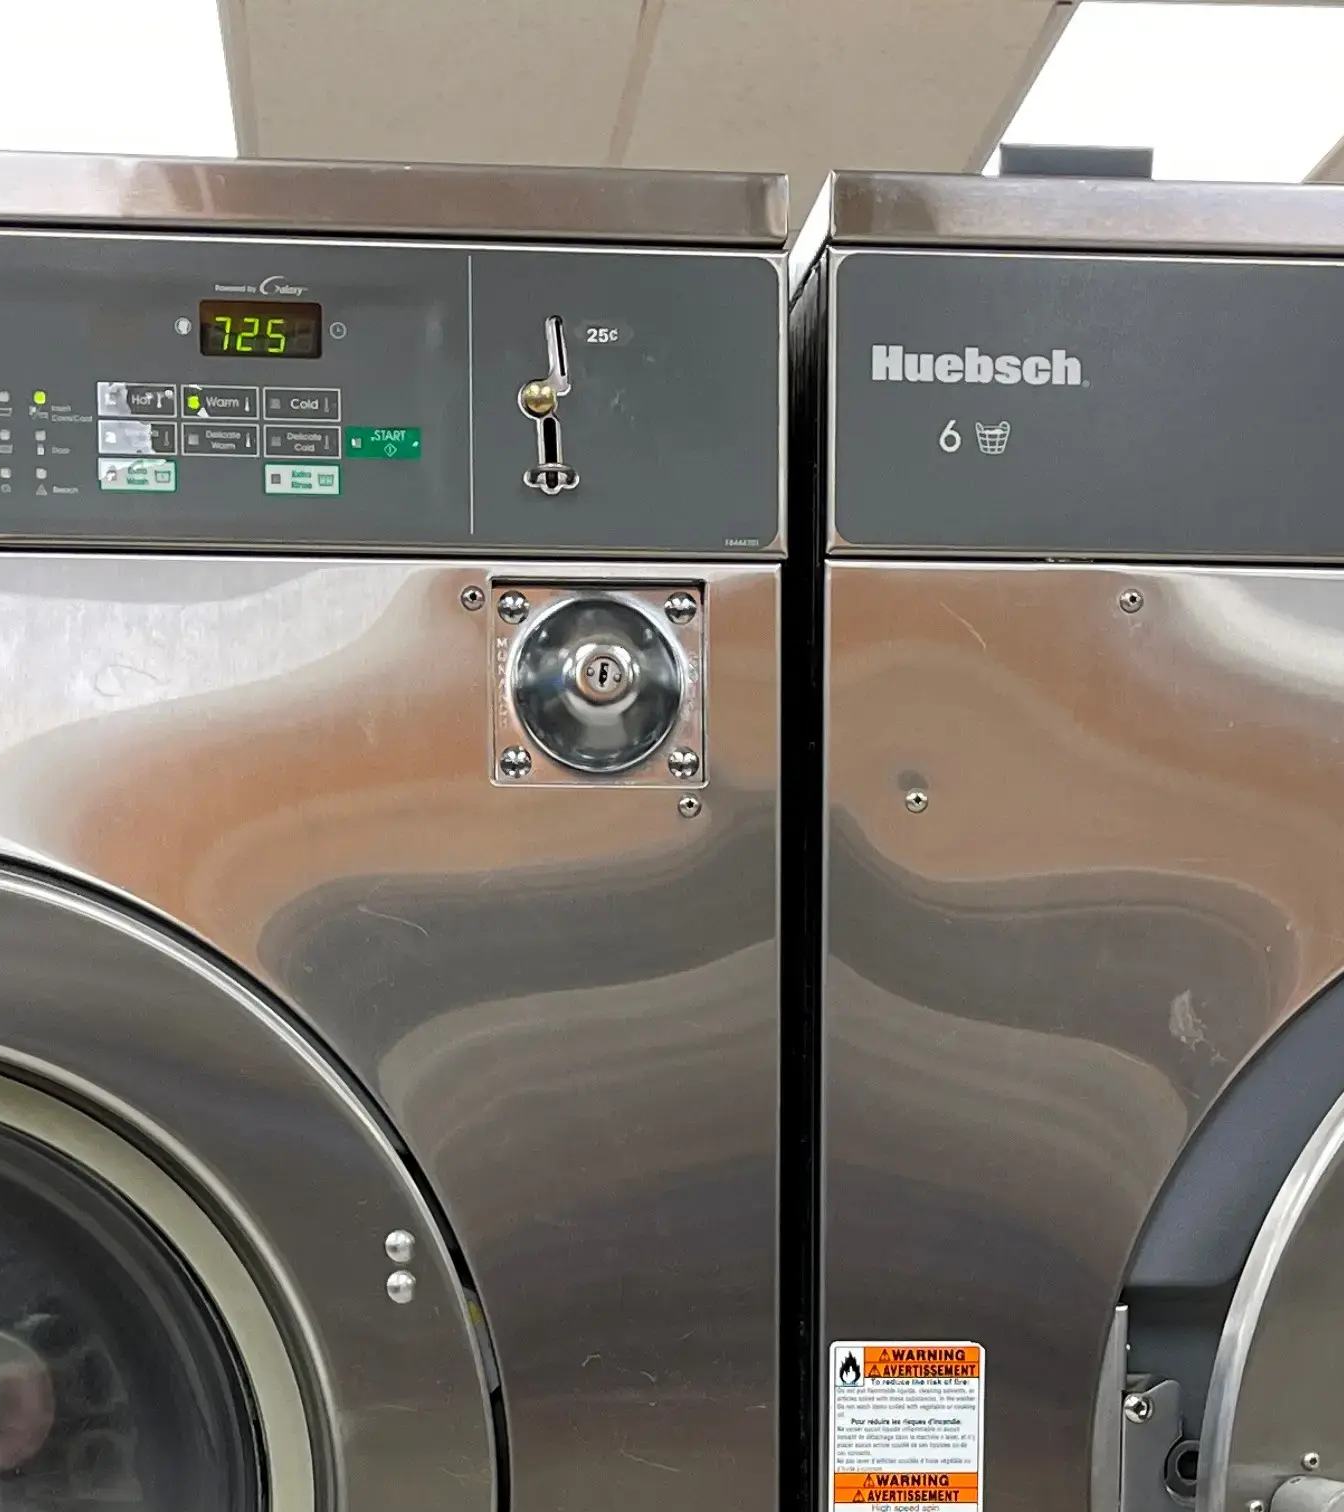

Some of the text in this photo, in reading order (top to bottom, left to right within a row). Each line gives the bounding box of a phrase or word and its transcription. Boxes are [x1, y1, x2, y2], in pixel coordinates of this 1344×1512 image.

[247, 285, 256, 294] by
[215, 317, 288, 354] 725
[587, 328, 619, 344] 25¢
[871, 344, 1081, 385] Huebsch
[206, 397, 240, 409] Warm
[290, 398, 319, 411] Cold
[206, 430, 241, 440] Delicate
[287, 432, 322, 442] Delicate
[373, 430, 406, 441] START
[939, 420, 961, 453] 6
[211, 440, 236, 450] Warm
[294, 443, 315, 453] Cold
[892, 1349, 965, 1361] WARNING
[883, 1365, 976, 1377] AVERTISSEMENT
[871, 1378, 880, 1386] To
[882, 1378, 910, 1386] reduce
[912, 1378, 924, 1386] the
[927, 1378, 942, 1386] risk
[944, 1378, 952, 1386] of
[877, 1474, 949, 1486] WARNING
[868, 1490, 959, 1502] AVERTISSEMENT
